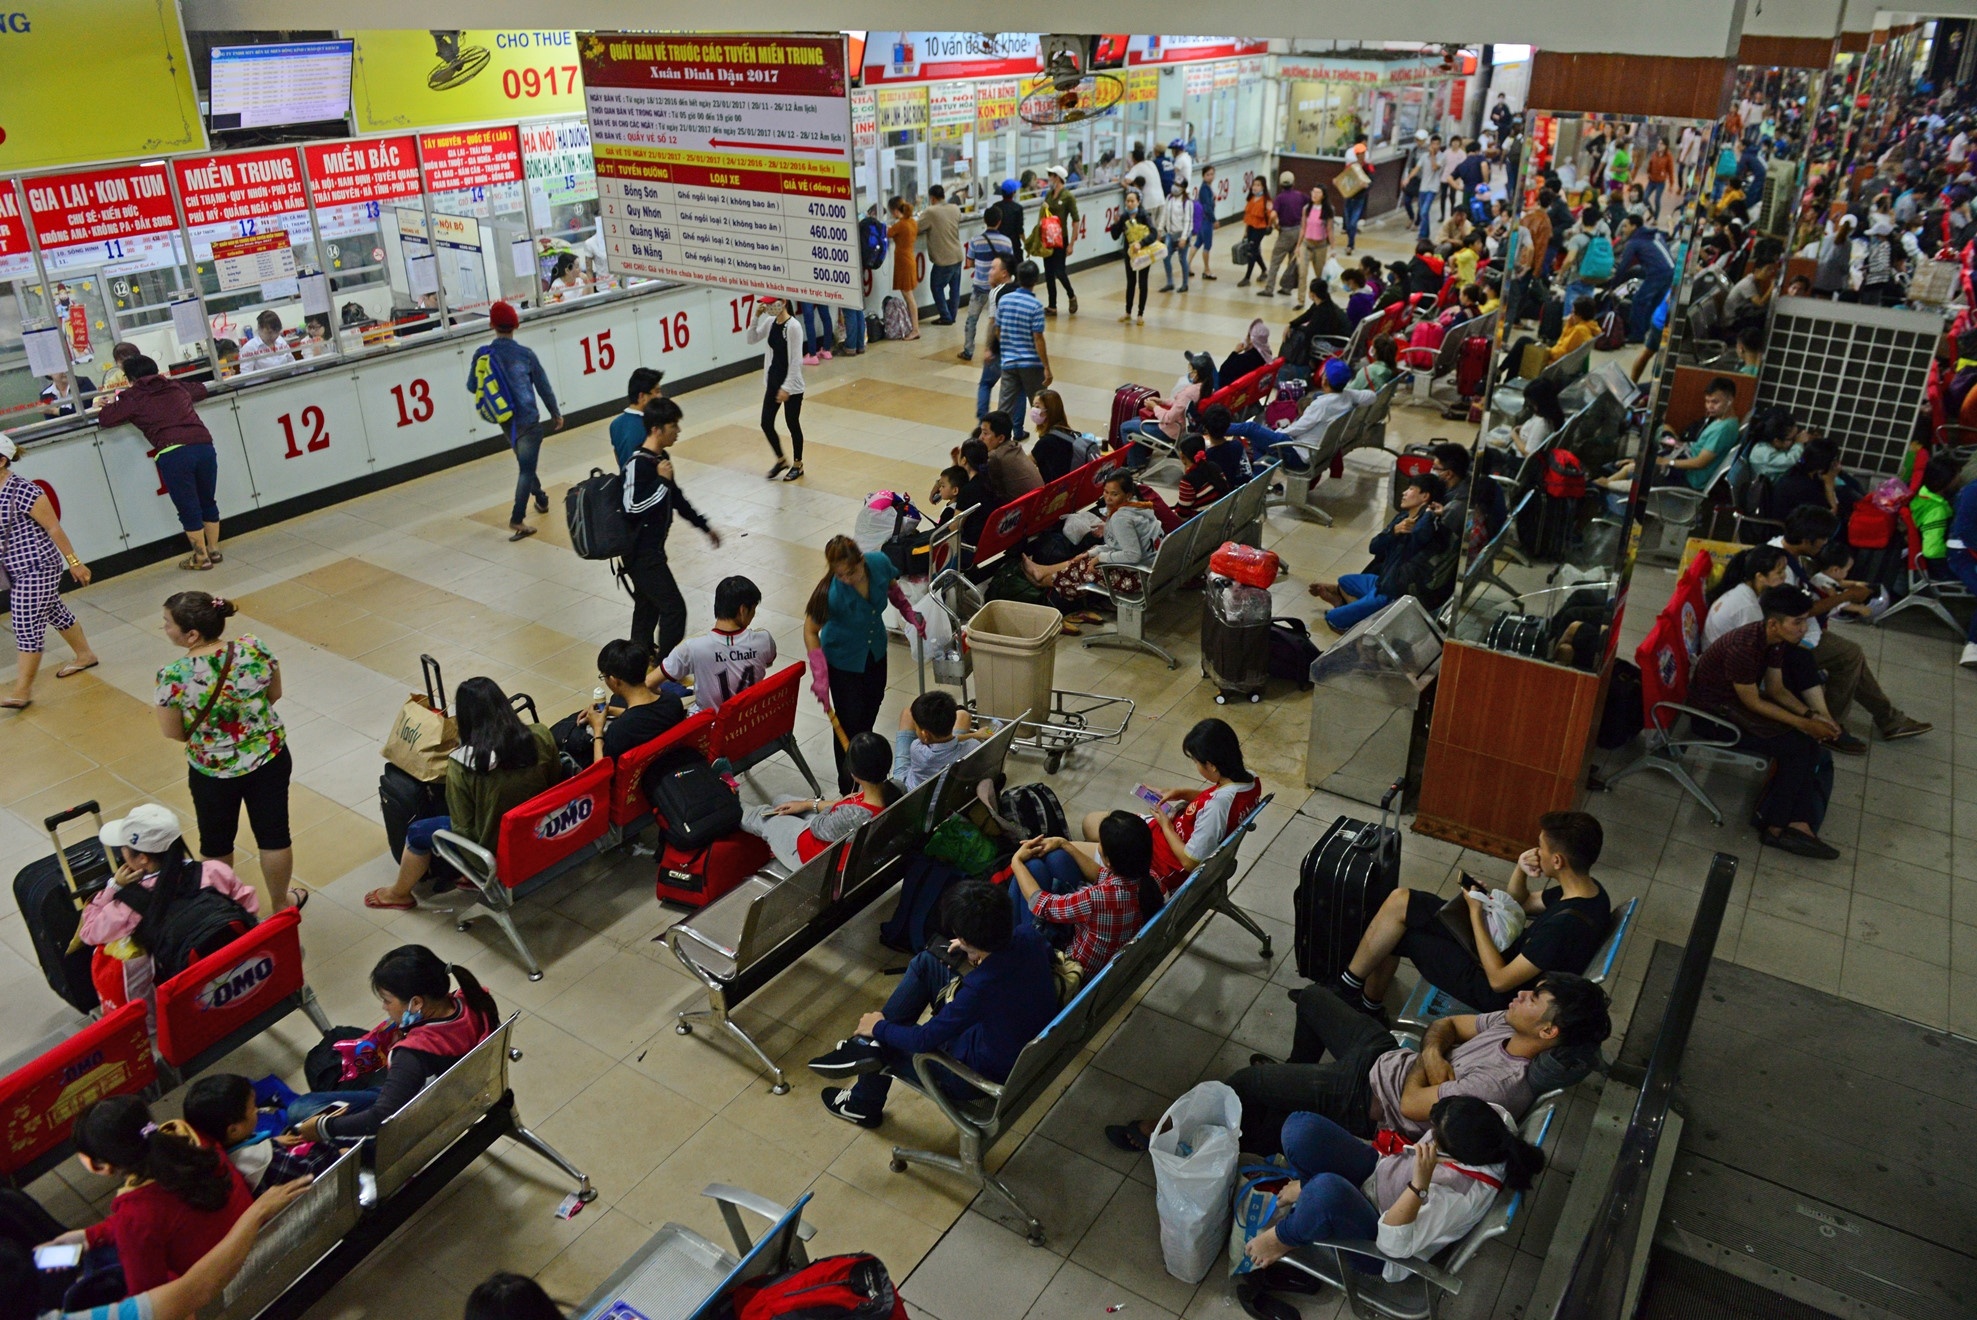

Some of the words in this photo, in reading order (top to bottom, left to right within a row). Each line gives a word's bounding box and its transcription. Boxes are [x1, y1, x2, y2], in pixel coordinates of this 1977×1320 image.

[496, 32, 529, 49] CHO
[925, 36, 939, 57] 10
[942, 34, 962, 56] vấn
[634, 41, 654, 61] BÁN
[654, 41, 667, 61] VÉ
[667, 42, 700, 62] TRƯỚC
[701, 42, 723, 63] CÁC
[723, 42, 757, 64] TUYẾN
[785, 46, 824, 66] TRUNG
[502, 65, 579, 100] 0917
[650, 66, 681, 79] Xuân
[684, 67, 714, 80] Đinh
[717, 68, 744, 86] Dậu
[746, 69, 779, 83] 2017
[1281, 66, 1311, 80] HƯỚNG
[1312, 64, 1330, 80] DẪN
[1332, 68, 1361, 82] THÔNG
[1363, 71, 1378, 83] TIN
[977, 105, 996, 119] KON
[998, 103, 1016, 117] TUM
[424, 138, 436, 149] TÂY
[522, 126, 537, 154] HÀ
[538, 125, 556, 156] NỘI
[669, 136, 678, 144] 12
[323, 144, 366, 174] MIỀN
[368, 140, 400, 169] BẮC
[184, 159, 235, 192] MIỀN
[237, 158, 294, 185] TRUNG
[321, 177, 335, 192] NỘI
[338, 175, 354, 187] NAM
[355, 173, 371, 186] ĐỊNH
[373, 169, 397, 183] TUYÊN
[397, 168, 419, 180] QUANG
[565, 175, 575, 190] 15
[597, 161, 606, 173] SỐ
[606, 164, 614, 174] TT
[618, 163, 641, 176] TUYẾN
[643, 165, 669, 179] ĐƯỜNG
[709, 173, 728, 187] LOẠI
[729, 175, 740, 185] XE
[784, 179, 798, 190] GIÁ
[798, 179, 809, 191] VÉ
[28, 187, 60, 213] GIA
[60, 182, 90, 209] LAI
[94, 179, 130, 205] KON
[130, 174, 166, 200] TUM
[185, 191, 199, 208] CHÍ
[200, 191, 227, 207] THẠNH
[230, 189, 246, 204] QUY
[288, 180, 301, 195] CÁT
[314, 191, 331, 203] THÁI
[331, 187, 360, 201] NGUYÊN
[363, 185, 373, 197] HÀ
[407, 180, 419, 192] THỌ
[472, 186, 484, 202] 14
[606, 184, 610, 194] 1
[644, 186, 658, 199] Sơn
[677, 191, 691, 200] Ghế
[707, 194, 719, 205] loại
[721, 195, 726, 203] 2
[752, 198, 765, 208] bao
[67, 210, 85, 226] CHƯ
[101, 206, 122, 222] KIẾN
[223, 202, 249, 219] QUẢNG
[251, 200, 269, 216] NGÃI
[273, 199, 283, 213] ĐÀ
[365, 201, 380, 219] 13
[609, 204, 614, 214] 2
[626, 204, 641, 219] Quy
[642, 205, 662, 219] Nhơn
[808, 202, 847, 219] 470.000
[40, 228, 69, 245] KRÔNG
[70, 226, 89, 242] ANA
[91, 221, 119, 238] KRÔNG
[120, 221, 131, 234] PA
[152, 215, 173, 229] SONG
[239, 219, 257, 237] 12
[439, 219, 452, 231] NỘI
[453, 219, 464, 233] BỘ
[611, 224, 617, 234] 3
[629, 223, 653, 240] Quảng
[654, 225, 671, 241] Ngãi
[810, 225, 848, 242] 460.000
[104, 239, 124, 259] 11
[614, 244, 619, 254] 4
[632, 243, 643, 256] Đà
[811, 246, 849, 263] 480.000
[813, 267, 851, 285] 500.000
[116, 283, 128, 295] 12
[730, 294, 755, 334] 17
[659, 311, 690, 353] 16
[580, 328, 616, 375] 15
[390, 378, 434, 428] 13
[277, 405, 330, 459] 12
[715, 652, 727, 662] K.
[729, 648, 757, 661] Chair
[212, 957, 273, 1007] OMO
